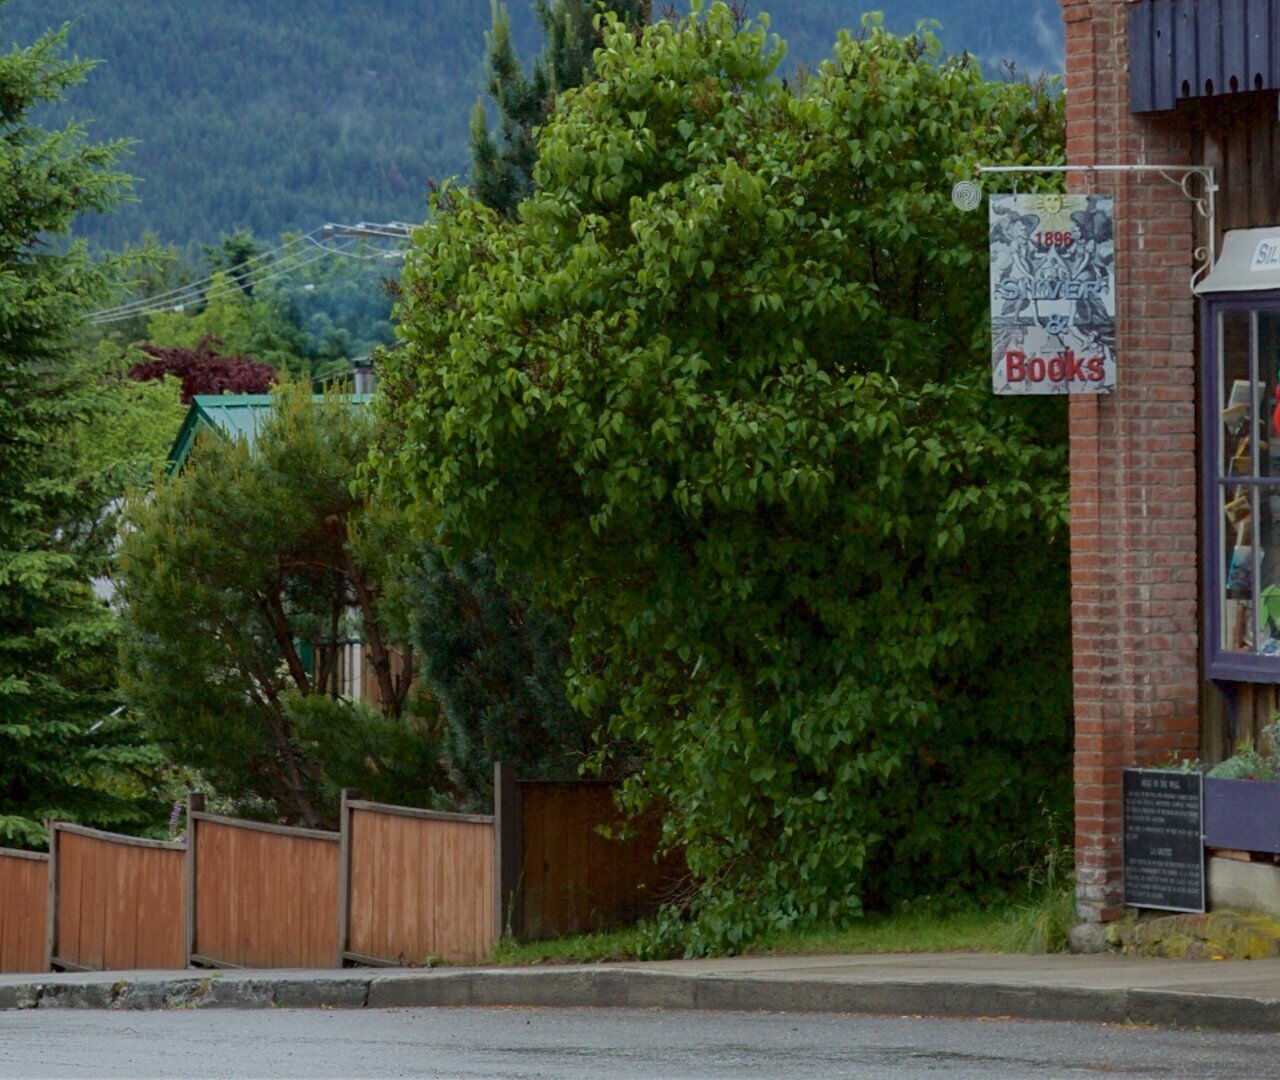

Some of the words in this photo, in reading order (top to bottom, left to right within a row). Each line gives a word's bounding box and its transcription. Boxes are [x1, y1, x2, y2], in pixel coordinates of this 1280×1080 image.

[1036, 231, 1074, 248] 1896
[1000, 278, 1104, 301] SILVER
[1046, 312, 1069, 335] &
[1005, 350, 1105, 383] Books
